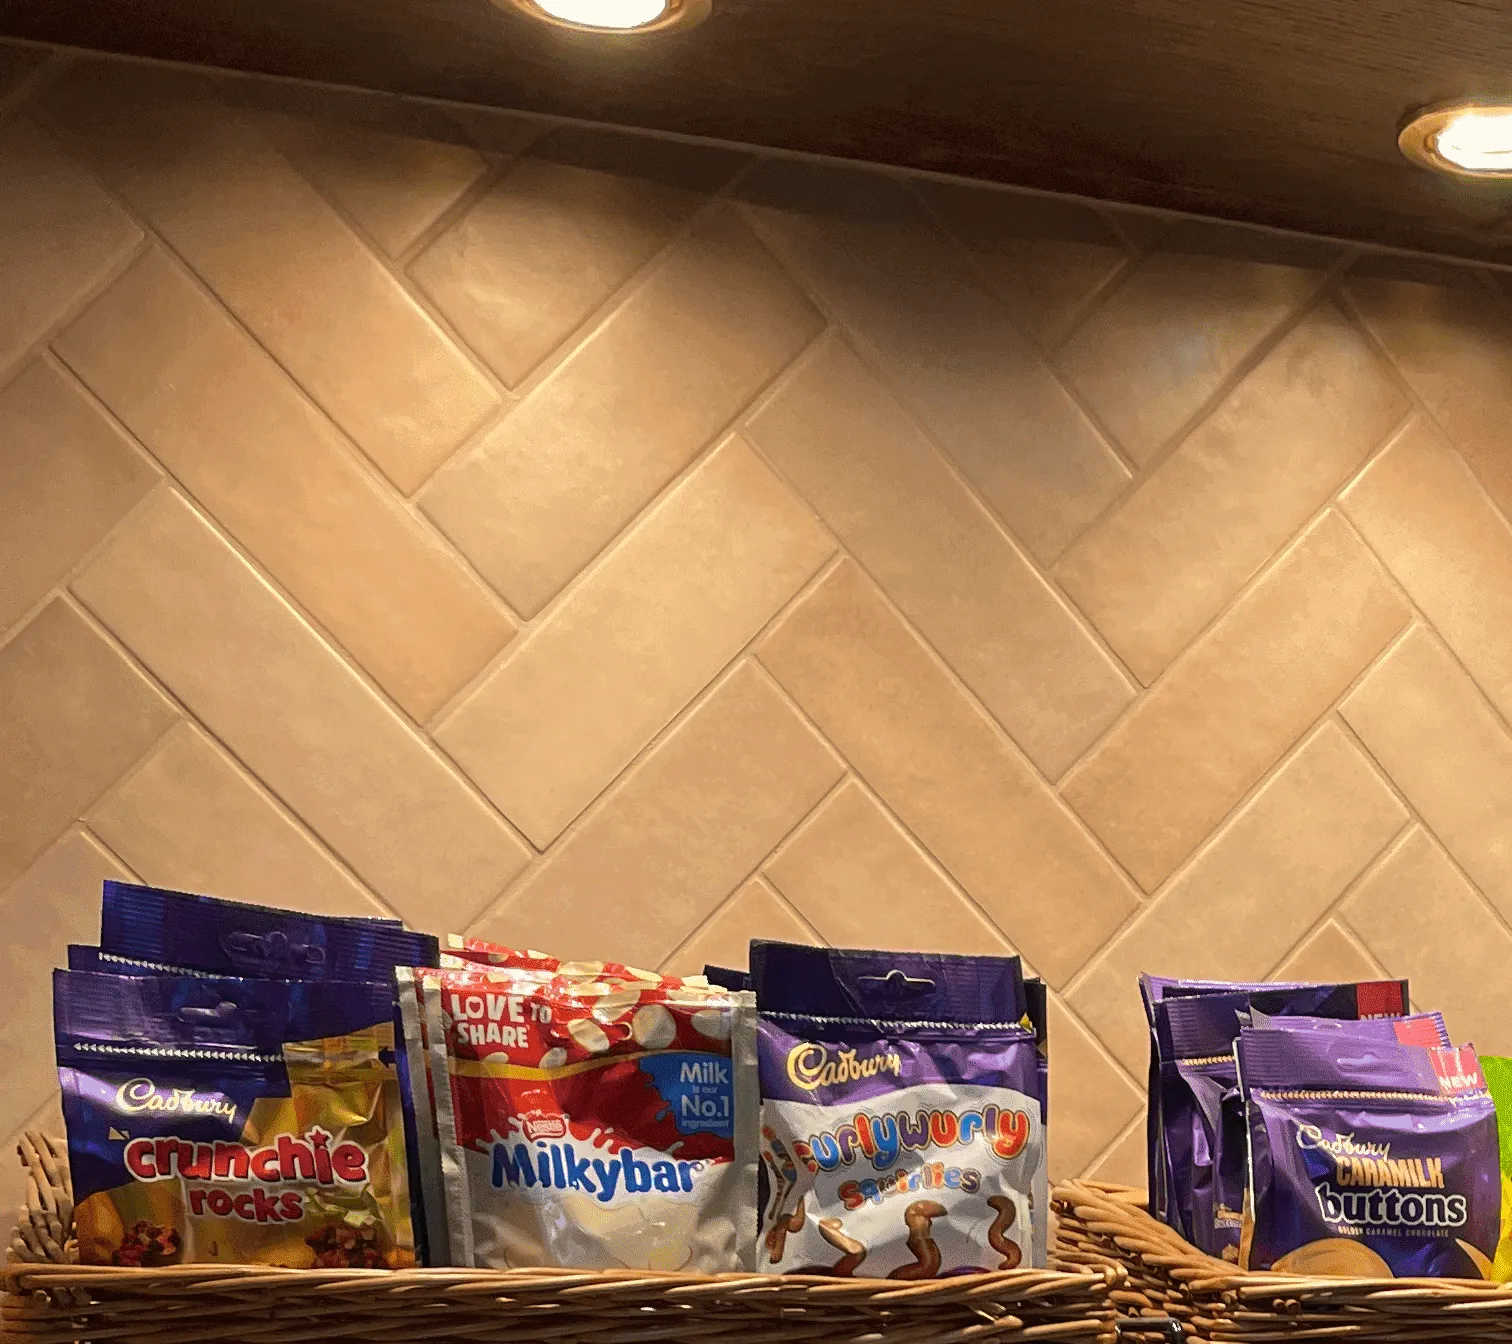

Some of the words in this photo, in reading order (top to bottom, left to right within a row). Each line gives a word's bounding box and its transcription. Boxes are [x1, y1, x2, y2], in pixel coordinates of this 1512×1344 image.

[450, 994, 525, 1022] LOVE
[531, 1003, 551, 1023] TO
[457, 1022, 529, 1049] SHARE
[680, 1062, 729, 1084] Milk
[787, 1042, 901, 1091] Cadbury
[1440, 1073, 1478, 1090] NEW
[116, 1078, 236, 1123] Cadbury
[681, 1096, 730, 1117] No.1
[125, 1126, 368, 1184] crunchie
[1296, 1124, 1391, 1160] Cadbury
[491, 1141, 698, 1203] Milkybar
[1335, 1156, 1446, 1190] CARAMILK
[189, 1186, 305, 1224] rocks
[1314, 1182, 1468, 1228] buttons
[1365, 1227, 1402, 1238] CARAMEL
